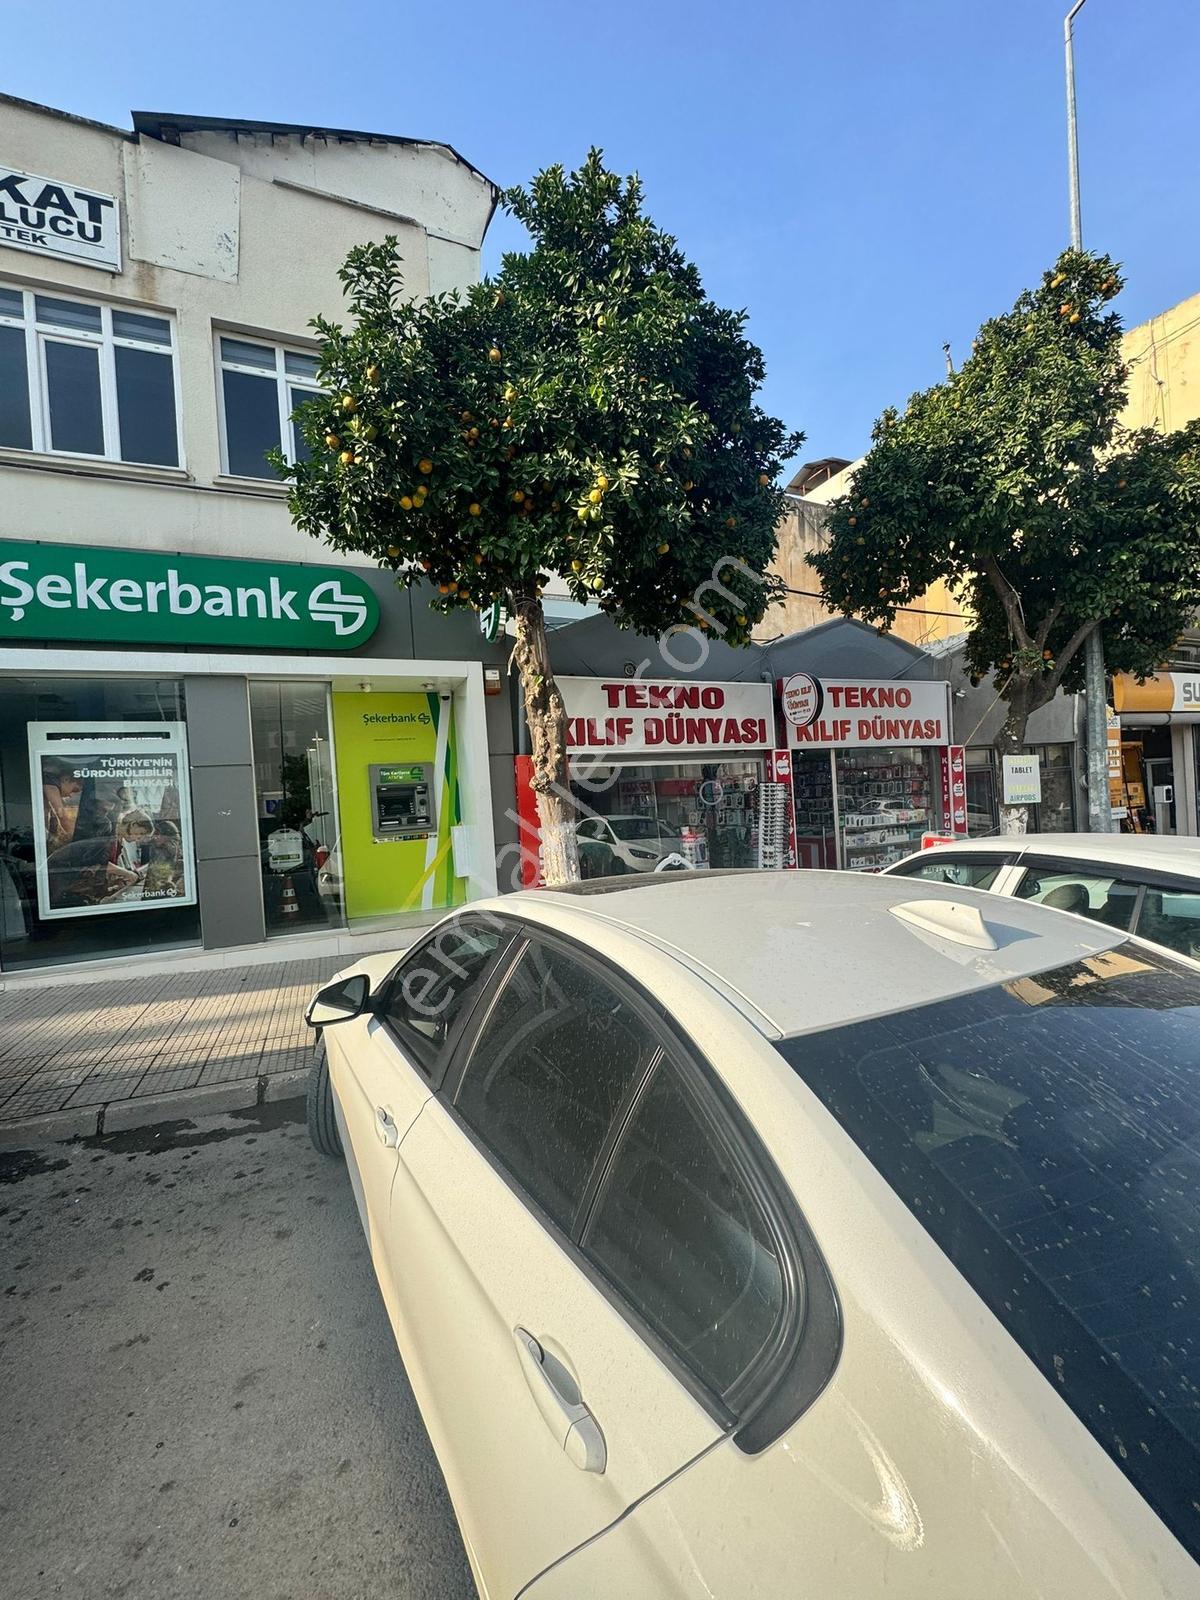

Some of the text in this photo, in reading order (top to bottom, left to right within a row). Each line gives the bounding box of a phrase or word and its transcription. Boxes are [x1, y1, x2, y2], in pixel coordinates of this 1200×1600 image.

[0, 561, 300, 622] Şekerbank
[601, 684, 725, 709] TEKNO
[827, 687, 912, 708] TEKNO
[363, 714, 416, 725] Şekerbank
[644, 713, 767, 744] DÜNYASI
[796, 715, 942, 742] KILIF DÜNYASI
[100, 757, 173, 767] TÜRKİYE'NİN
[1011, 766, 1032, 774] TABLET
[73, 767, 173, 778] SÜRDÜRÜLEBİLİR
[941, 757, 949, 802] KILIF
[123, 779, 173, 787] BANKASI
[122, 889, 166, 901] Şekerbank
